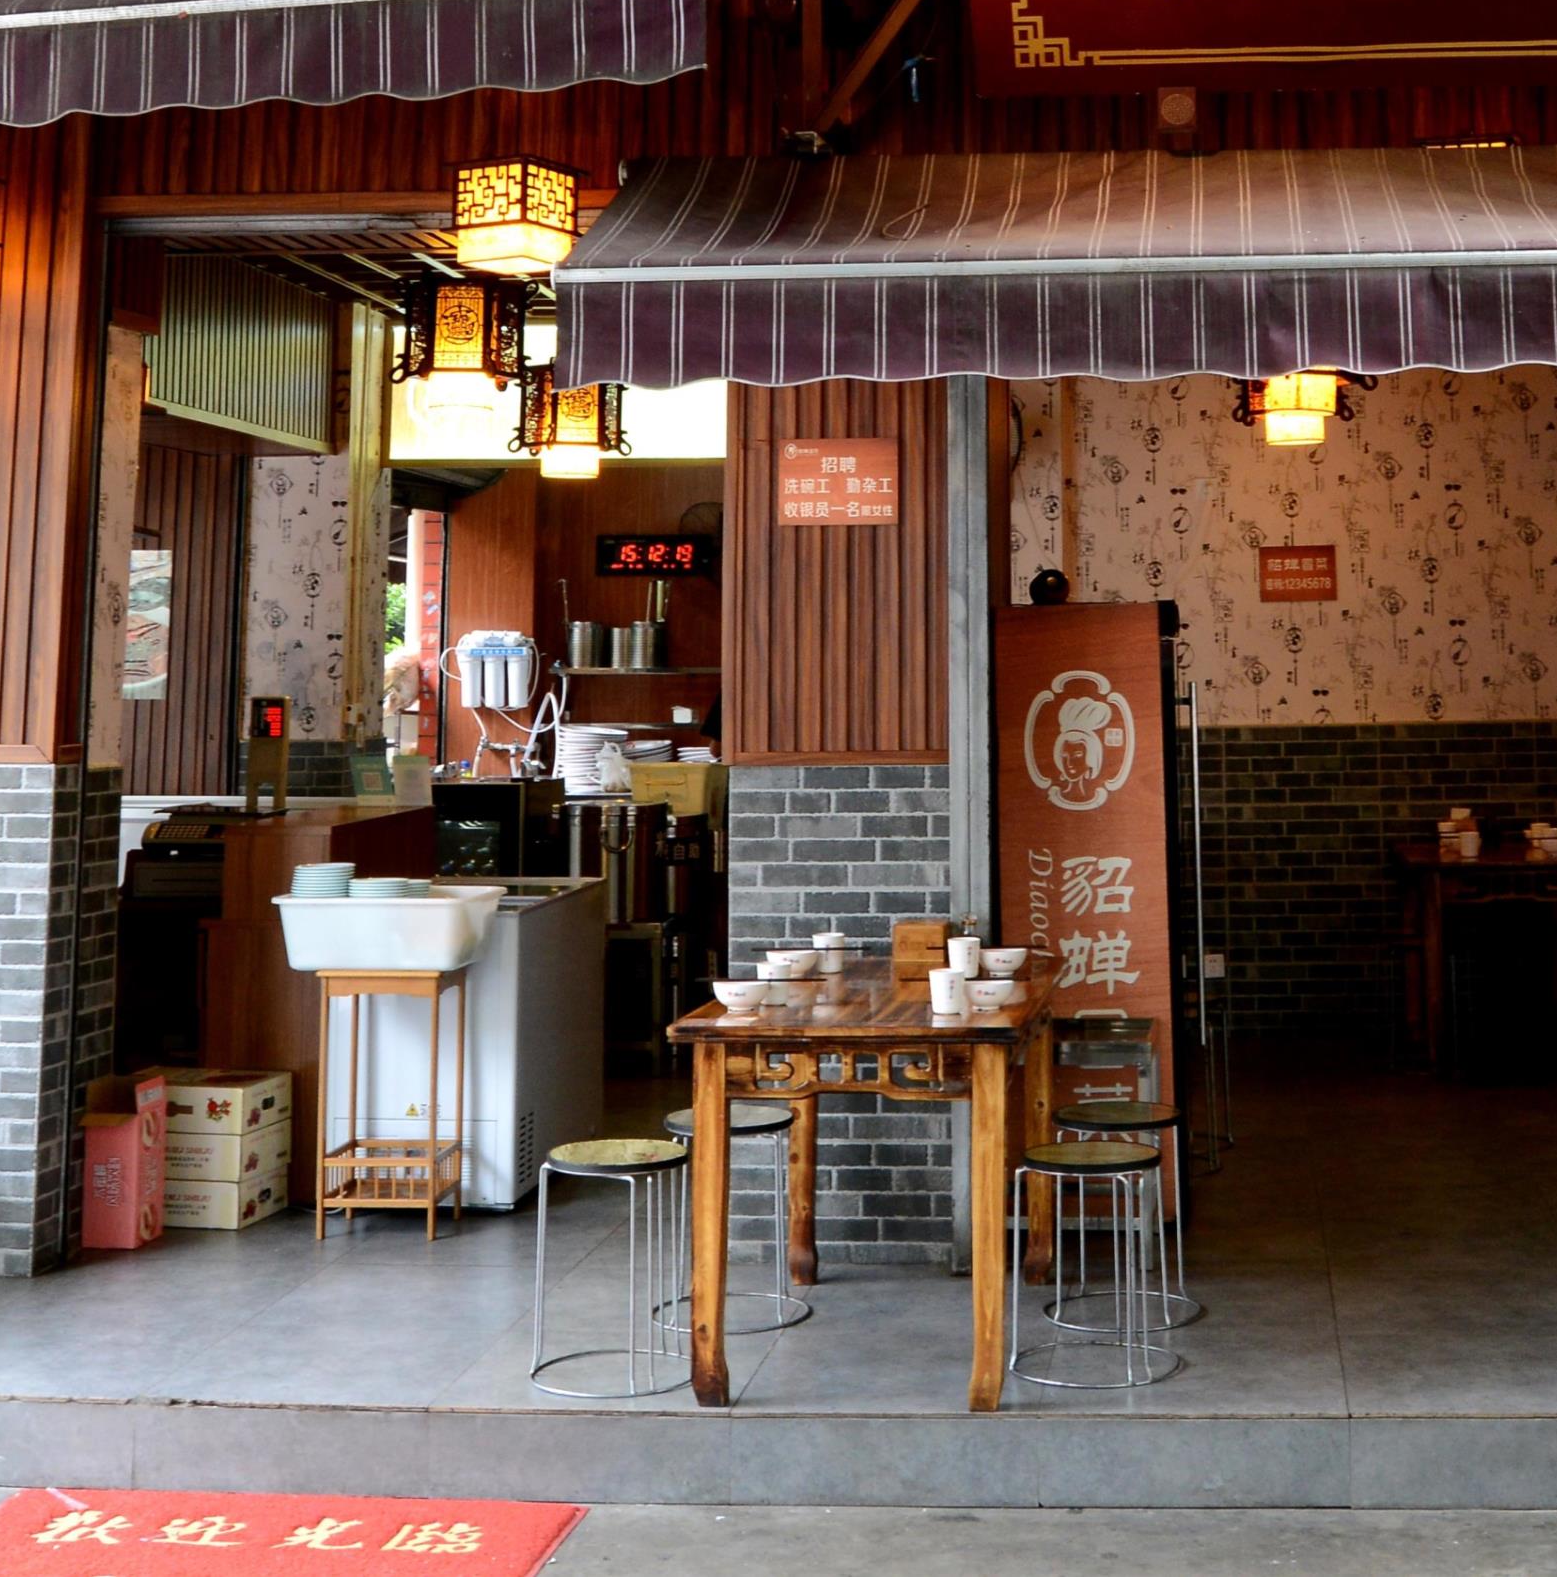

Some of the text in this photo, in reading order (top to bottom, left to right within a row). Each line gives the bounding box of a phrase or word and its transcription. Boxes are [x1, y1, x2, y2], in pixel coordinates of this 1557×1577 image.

[821, 457, 857, 474] 招聘
[784, 478, 830, 495] 洗碗工
[1028, 848, 1055, 958] Diaoc
